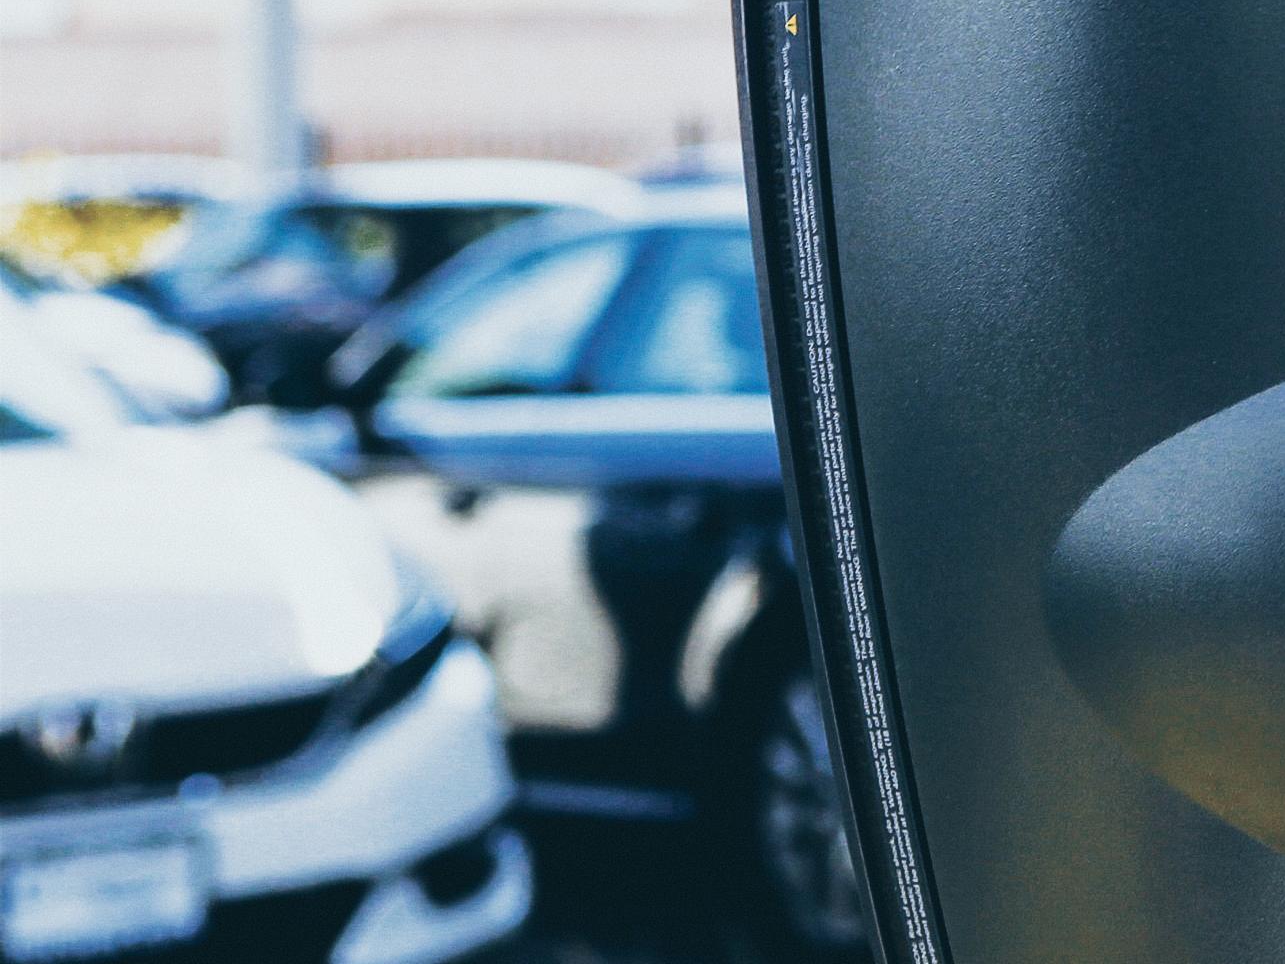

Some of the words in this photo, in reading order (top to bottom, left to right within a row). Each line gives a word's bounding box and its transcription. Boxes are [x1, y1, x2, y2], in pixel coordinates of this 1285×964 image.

[789, 146, 797, 165] any
[804, 143, 813, 177] during
[807, 179, 817, 233] ventilation
[795, 217, 805, 257] product
[812, 235, 824, 281] requiring
[809, 287, 816, 298] to
[805, 320, 812, 336] Do
[812, 301, 822, 345] exposed
[819, 303, 829, 345] vehicles
[816, 348, 823, 361] be
[818, 364, 826, 381] not
[824, 347, 836, 392] charging
[821, 383, 830, 418] should
[829, 395, 837, 408] for
[825, 420, 833, 440] that
[833, 410, 841, 433] only
[821, 431, 829, 457] parts
[830, 442, 838, 468] parts
[836, 434, 847, 481] intended
[824, 459, 837, 516] serviceable
[833, 470, 845, 513] sparking
[842, 483, 848, 491] is
[840, 516, 846, 527] or
[844, 493, 854, 527] device
[835, 542, 843, 558] No
[843, 529, 852, 560] arcing
[848, 529, 857, 550] This
[846, 562, 854, 580] has
[847, 614, 855, 631] the
[851, 582, 865, 638] equipment
[852, 633, 861, 660] open
[859, 640, 867, 660] This
[867, 640, 875, 657] the
[871, 660, 881, 691] above
[872, 716, 879, 727] of
[875, 729, 883, 749] Risk
[903, 829, 915, 867] located
[896, 869, 907, 904] electric
